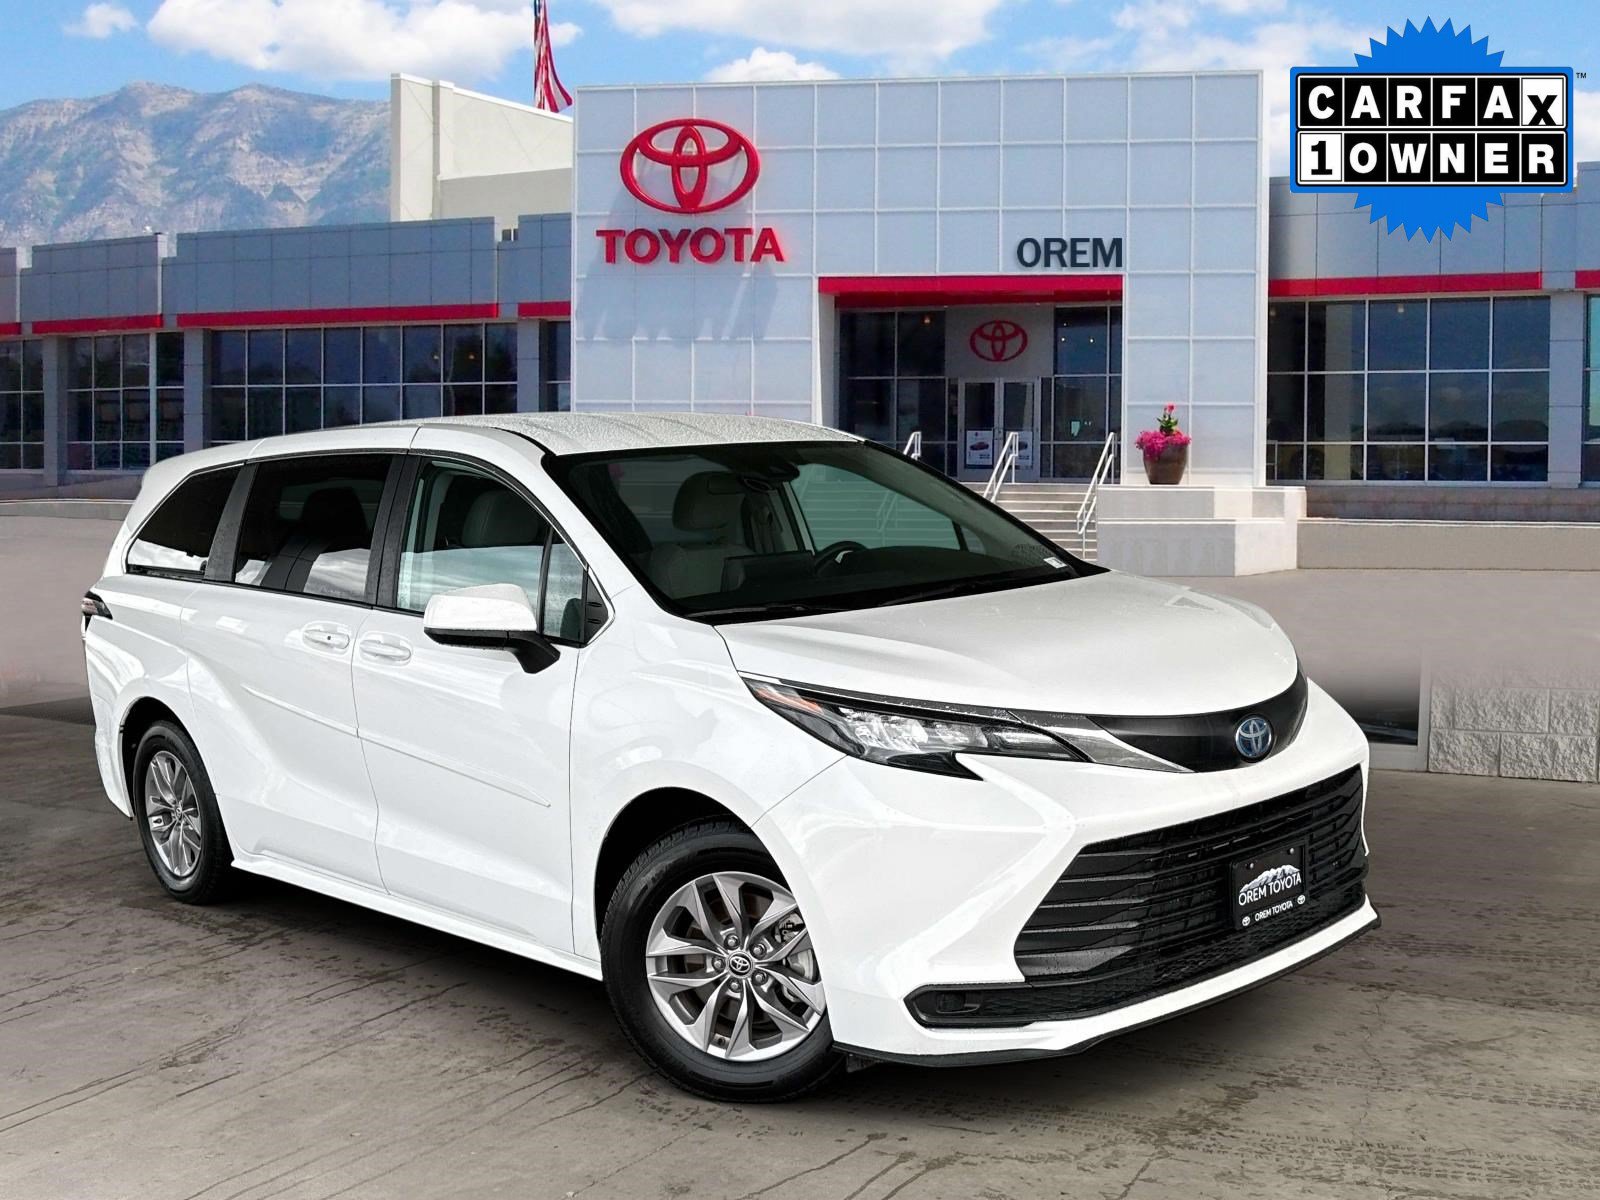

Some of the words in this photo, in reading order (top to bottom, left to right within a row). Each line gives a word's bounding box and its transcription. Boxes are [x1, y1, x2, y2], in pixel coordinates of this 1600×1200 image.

[596, 227, 785, 264] TOYOTA
[1017, 237, 1123, 268] OREM
[1239, 885, 1266, 905] OREM
[1269, 873, 1301, 894] TOYOTA
[1255, 908, 1271, 921] OREM
[1272, 901, 1293, 914] TOYOTA
